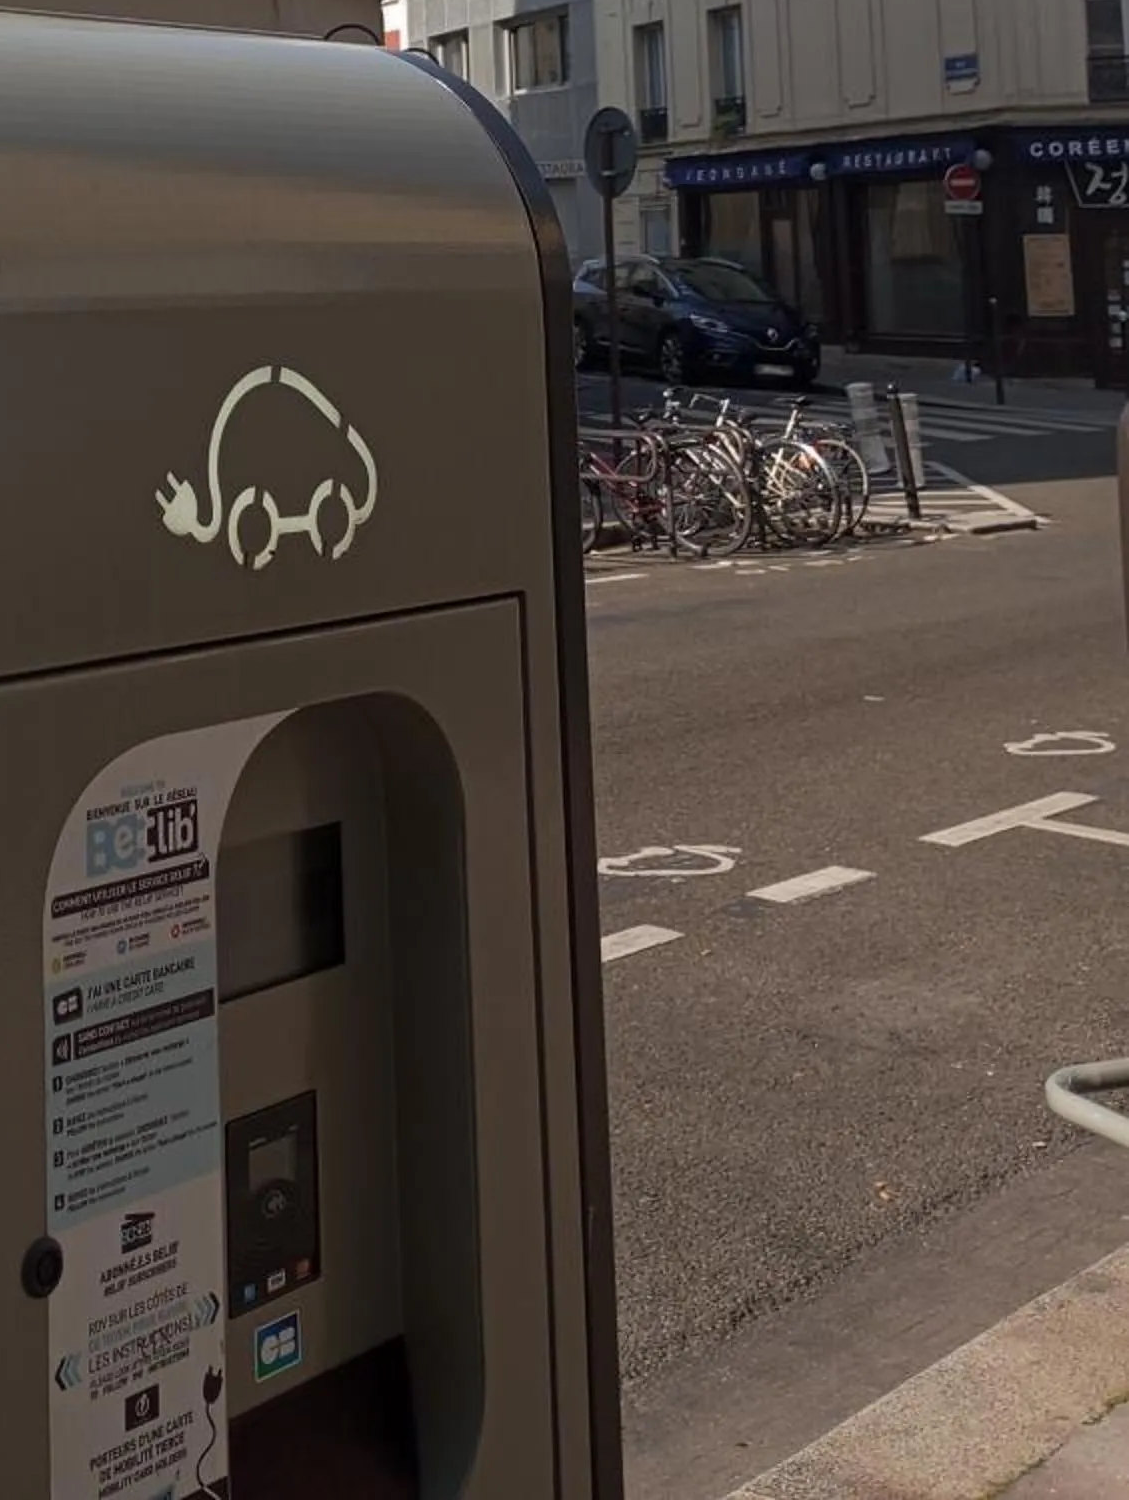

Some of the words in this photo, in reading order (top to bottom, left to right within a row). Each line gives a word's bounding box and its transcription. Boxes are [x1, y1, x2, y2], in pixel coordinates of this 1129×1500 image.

[843, 147, 952, 169] RESTAURANT
[86, 801, 130, 821] BIENVENUE
[134, 796, 149, 810] SUR
[154, 793, 164, 804] LE
[138, 874, 168, 891] SERVICE
[104, 978, 122, 996] UNE
[124, 969, 151, 989] CARTE
[153, 956, 196, 981] BANCAIRE
[109, 1308, 127, 1327] SUR
[128, 1301, 145, 1318] LES
[89, 1351, 109, 1374] LES
[90, 1438, 136, 1472] PORTEURS
[167, 1411, 193, 1434] CARTE
[113, 1446, 153, 1474] MOBILITÉ
[156, 1431, 184, 1455] TIERCE
